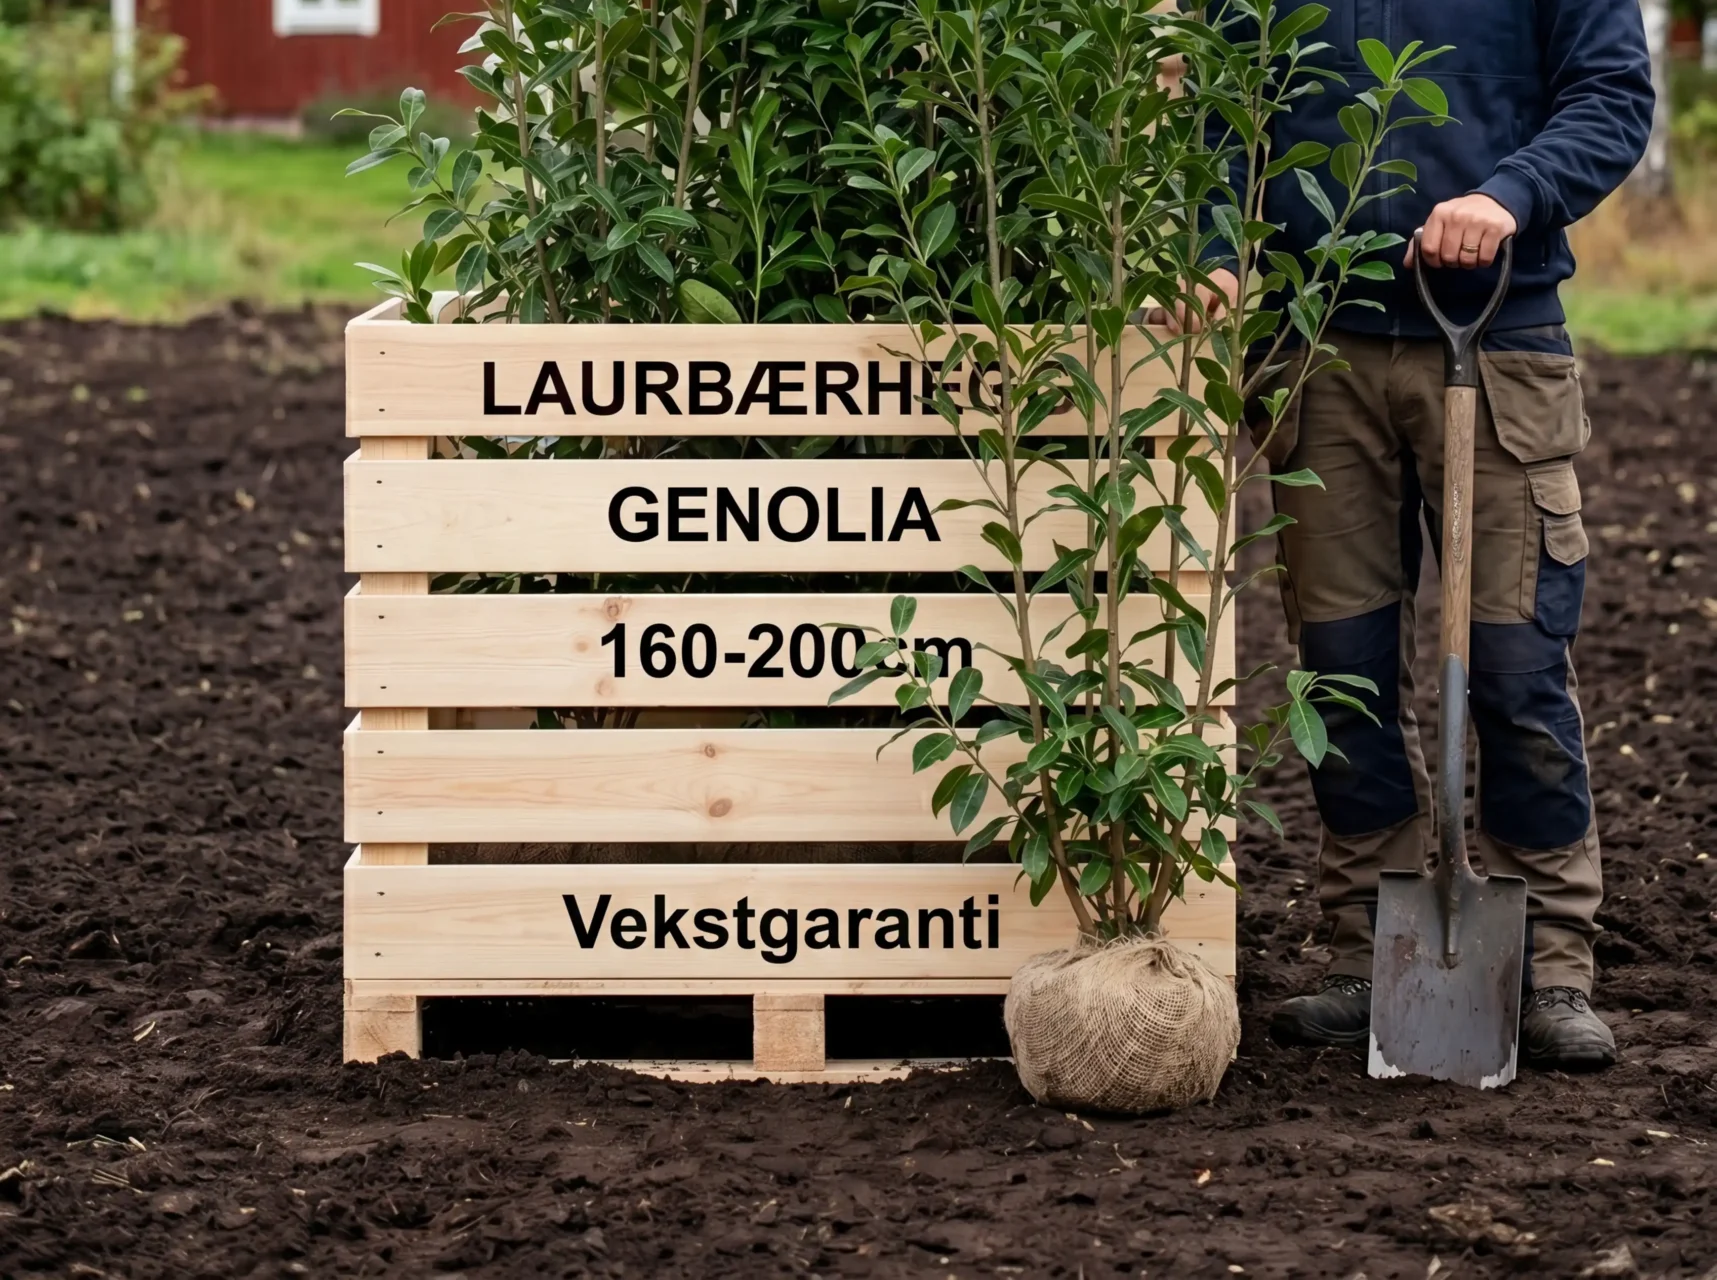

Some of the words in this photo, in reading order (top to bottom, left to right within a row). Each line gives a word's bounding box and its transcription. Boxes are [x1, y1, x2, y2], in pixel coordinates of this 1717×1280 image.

[608, 486, 941, 542] GENOLIA
[601, 622, 972, 678] 160-200cm
[562, 894, 1000, 964] Vekstgaranti
